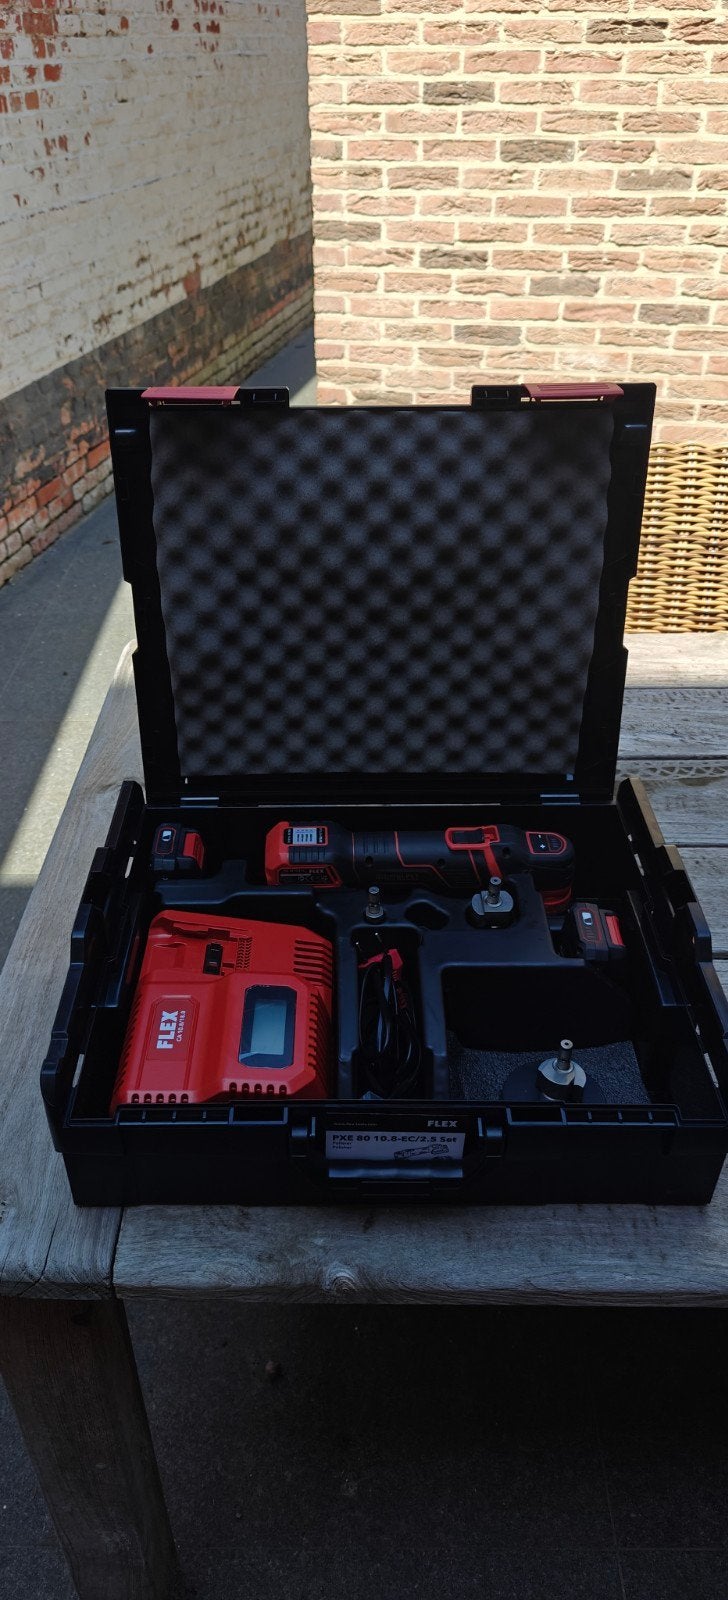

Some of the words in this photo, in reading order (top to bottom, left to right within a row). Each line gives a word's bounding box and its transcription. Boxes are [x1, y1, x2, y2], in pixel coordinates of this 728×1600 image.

[156, 1010, 179, 1049] FLEX
[176, 1034, 183, 1042] CA
[427, 1120, 458, 1128] FLEX
